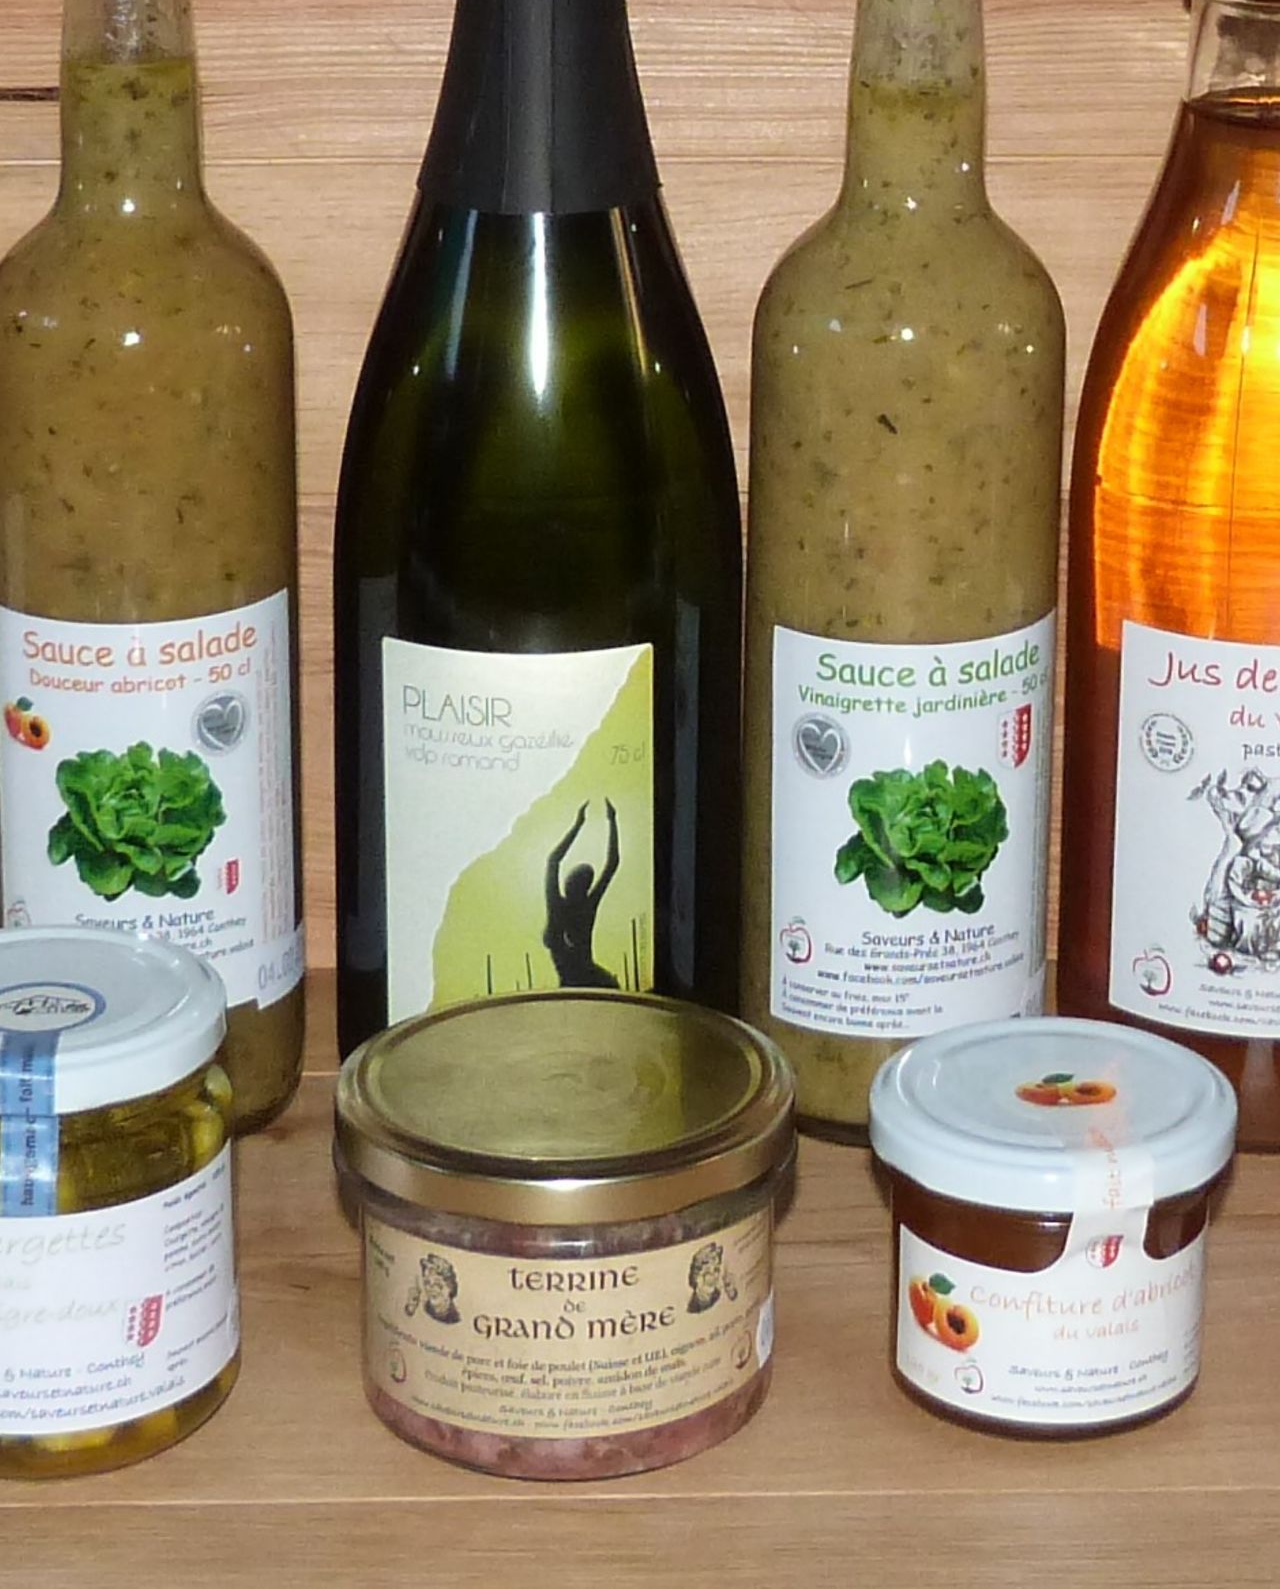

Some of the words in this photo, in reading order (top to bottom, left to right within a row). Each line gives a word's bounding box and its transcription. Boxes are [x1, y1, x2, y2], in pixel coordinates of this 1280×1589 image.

[23, 630, 115, 667] Sauce
[126, 636, 146, 666] à
[158, 621, 258, 665] salade
[30, 667, 103, 693] Douceur
[110, 673, 185, 694] abricot
[208, 664, 232, 684] 50
[238, 658, 251, 677] cl
[816, 653, 915, 687] Sauce
[929, 656, 948, 687] à
[958, 640, 1040, 685] salade
[1148, 652, 1221, 687] Jus
[1236, 659, 1278, 692] de
[402, 685, 512, 727] PLAISIR
[798, 685, 907, 714] Vinaigrette
[912, 689, 1008, 717] jardinière
[1022, 675, 1038, 695] 50
[1229, 706, 1265, 727] du
[611, 746, 630, 765] 75
[634, 742, 646, 761] cl
[160, 909, 214, 928] Nature
[862, 931, 924, 946] Saveurs
[945, 924, 995, 944] Nature
[970, 1285, 1102, 1320] Confiture
[473, 1314, 575, 1340] GRAND
[588, 1306, 676, 1340] MÈRE
[1053, 1320, 1078, 1340] du
[1086, 1319, 1139, 1338] valais
[88, 1353, 145, 1374] Conthey
